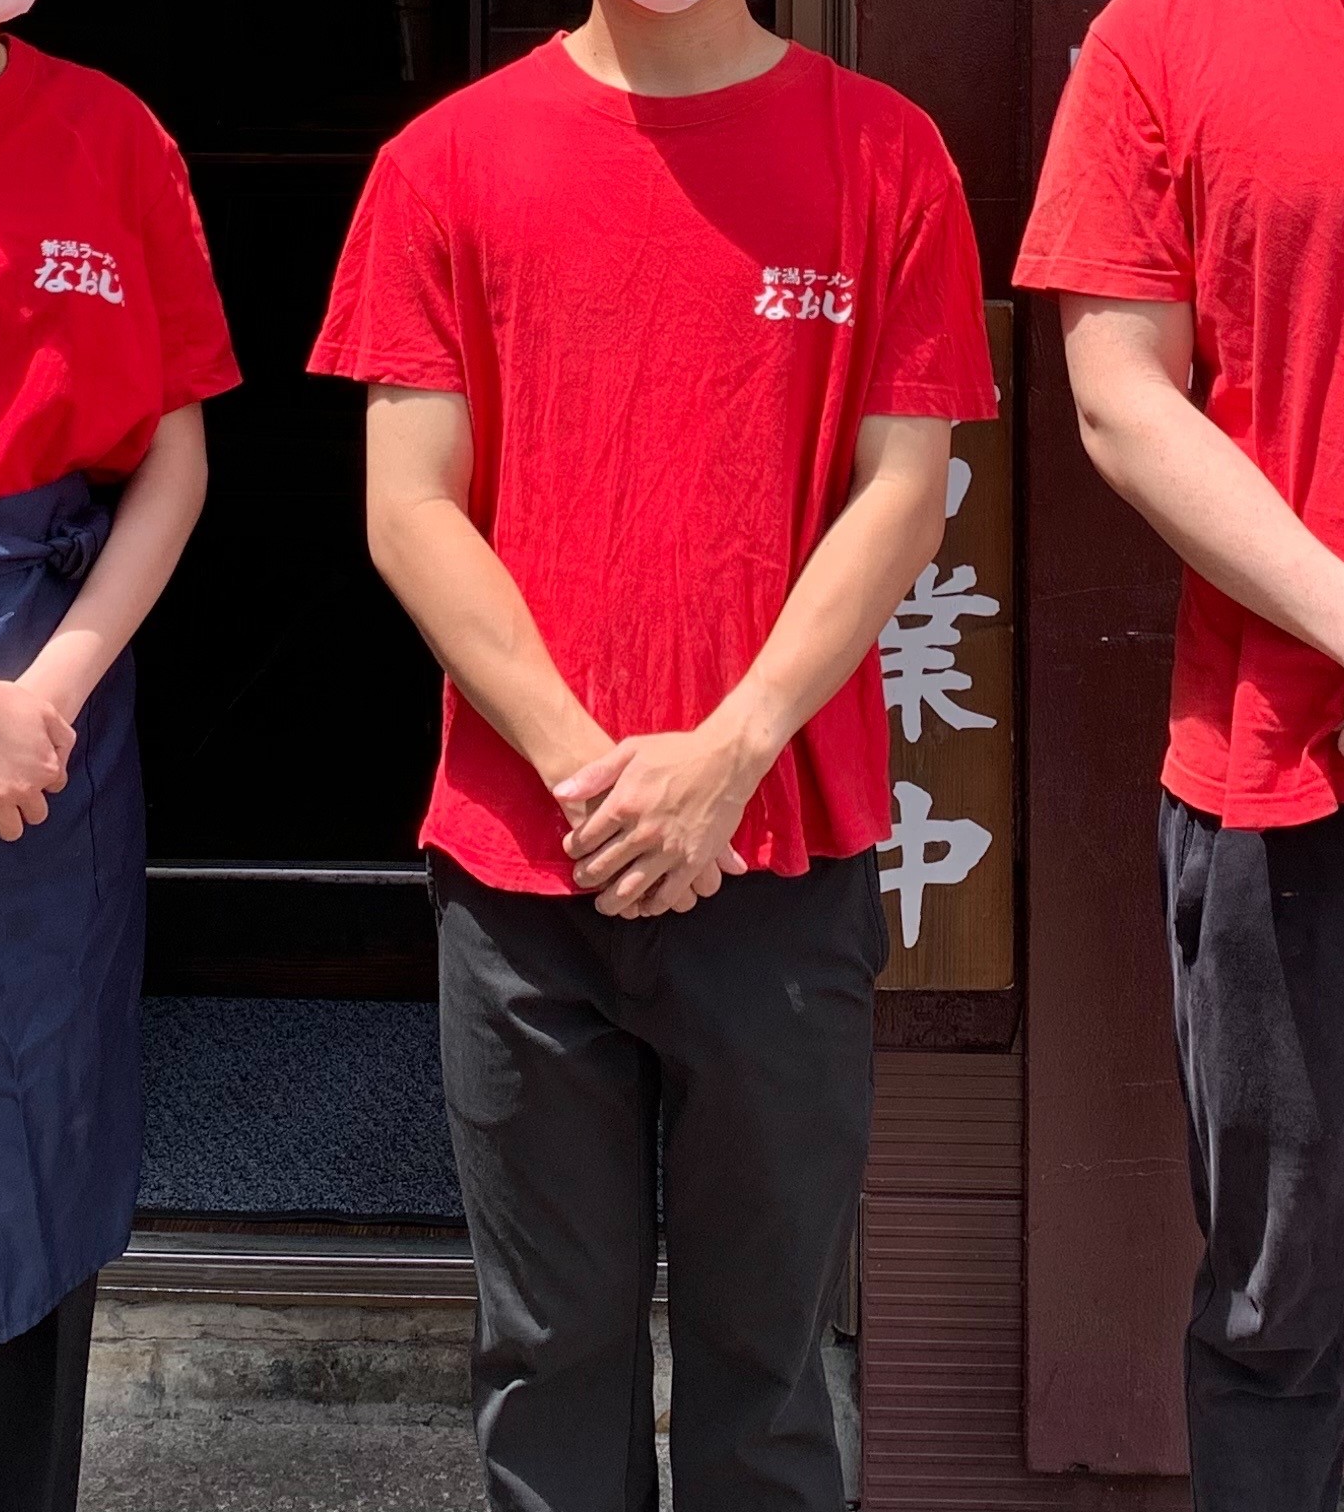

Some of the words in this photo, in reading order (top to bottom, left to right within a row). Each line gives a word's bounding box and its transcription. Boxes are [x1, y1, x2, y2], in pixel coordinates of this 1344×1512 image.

[762, 266, 854, 288] 新潟ラーメン
